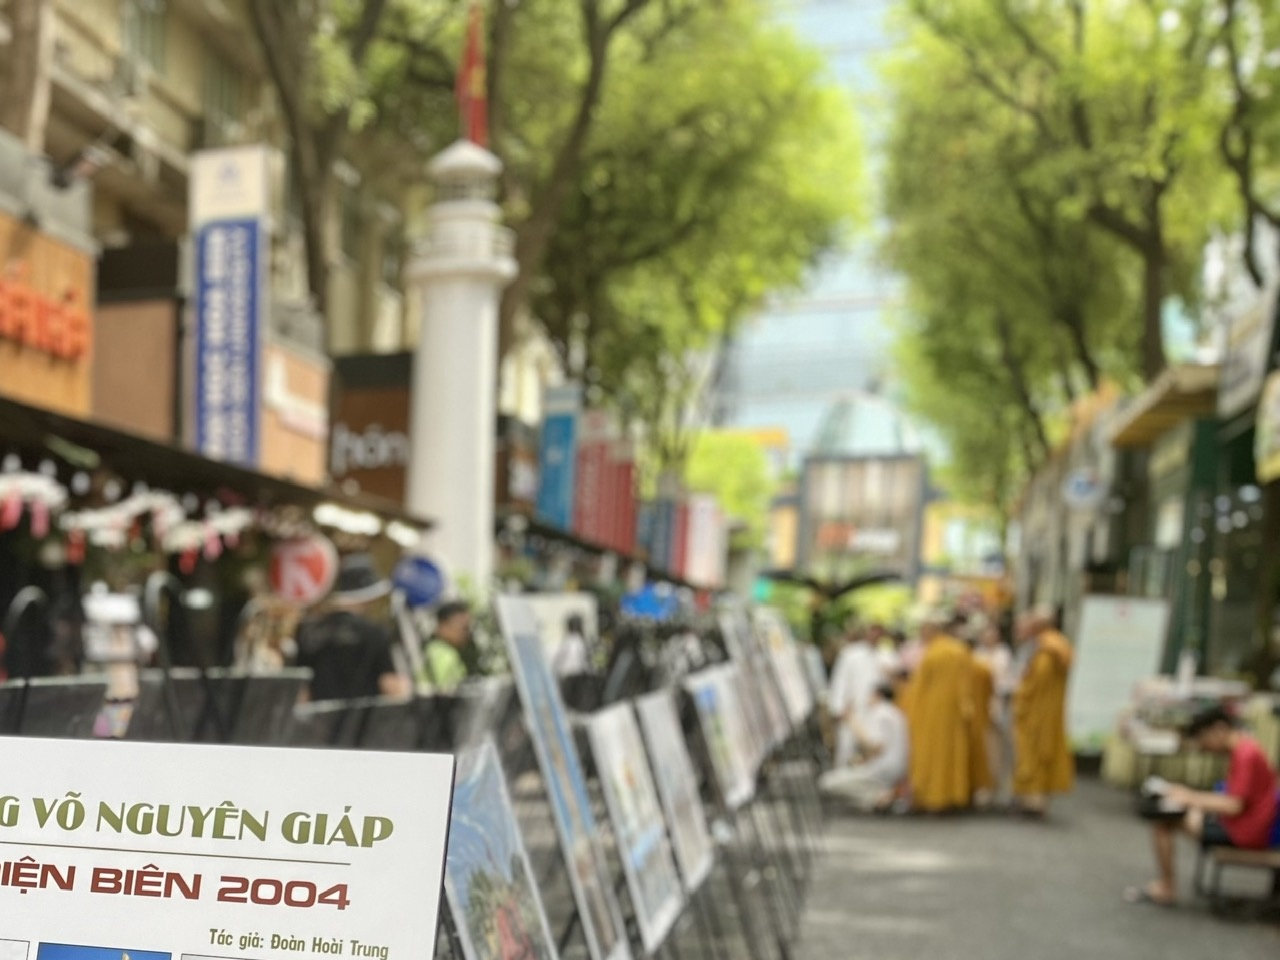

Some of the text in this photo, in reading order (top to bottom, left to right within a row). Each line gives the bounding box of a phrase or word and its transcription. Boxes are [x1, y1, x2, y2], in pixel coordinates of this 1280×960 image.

[32, 791, 86, 831] VÕ
[96, 800, 270, 842] NGUYÊN
[281, 805, 395, 848] GIÁP
[90, 863, 202, 900] BIÊN
[216, 875, 352, 911] 2004
[209, 928, 234, 946] Tác
[239, 931, 265, 950] giả:
[270, 933, 306, 953] Đoàn
[312, 936, 344, 955] Hoài
